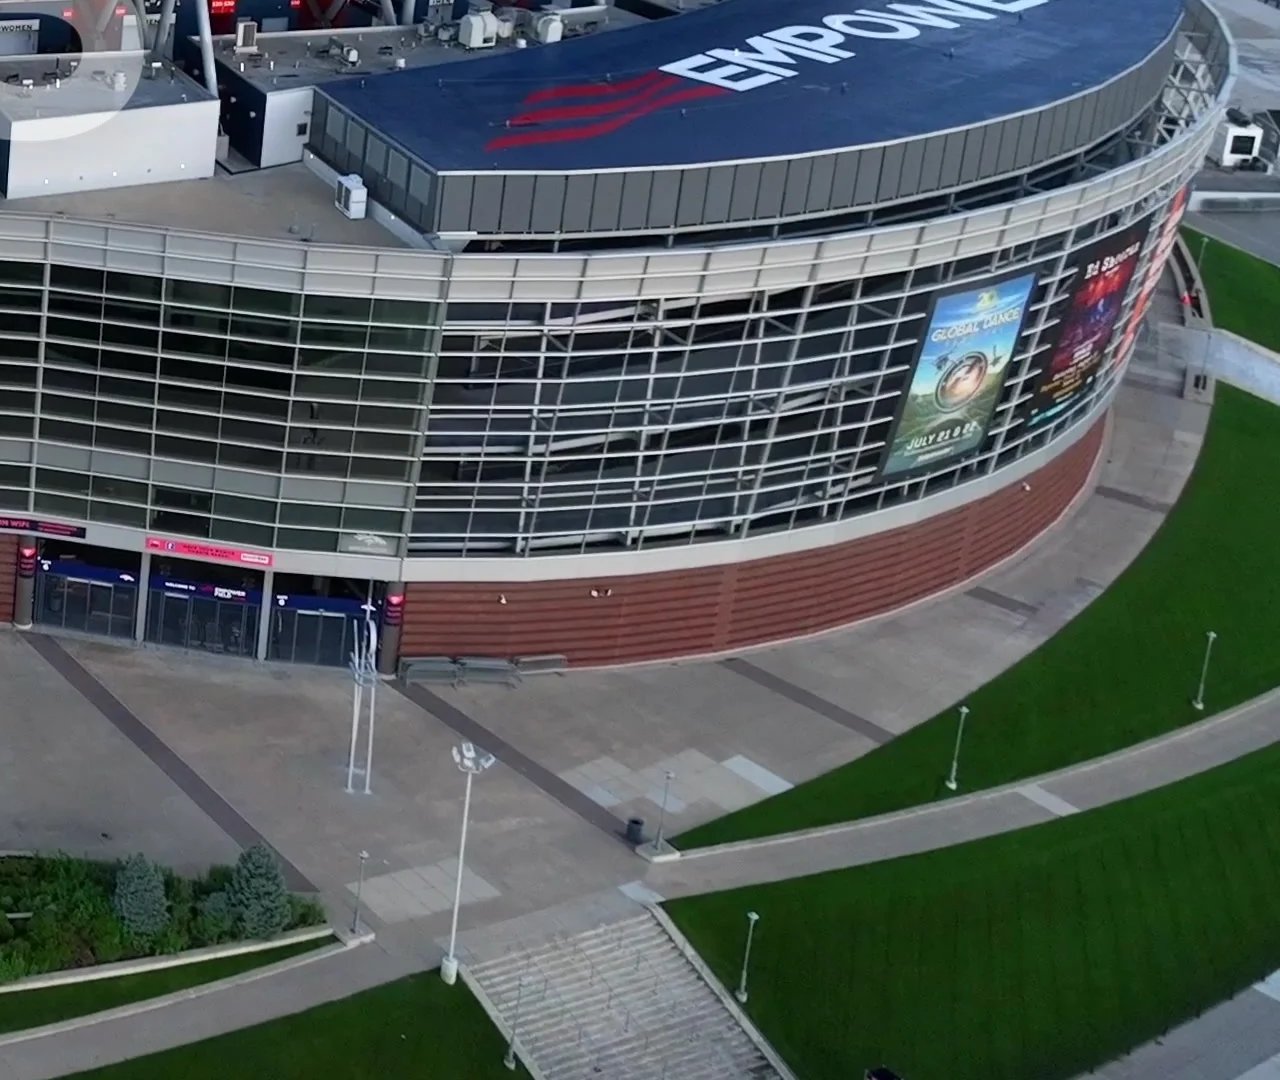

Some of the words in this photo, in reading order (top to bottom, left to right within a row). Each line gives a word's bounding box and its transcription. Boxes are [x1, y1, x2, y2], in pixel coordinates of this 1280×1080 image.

[1084, 261, 1101, 280] Ed
[931, 322, 980, 342] GLOBAL
[983, 308, 1021, 330] DANCE
[906, 433, 936, 450] JULY
[10, 520, 30, 528] WIFI
[214, 587, 246, 597] EMPOWER
[214, 591, 232, 599] FIELD
